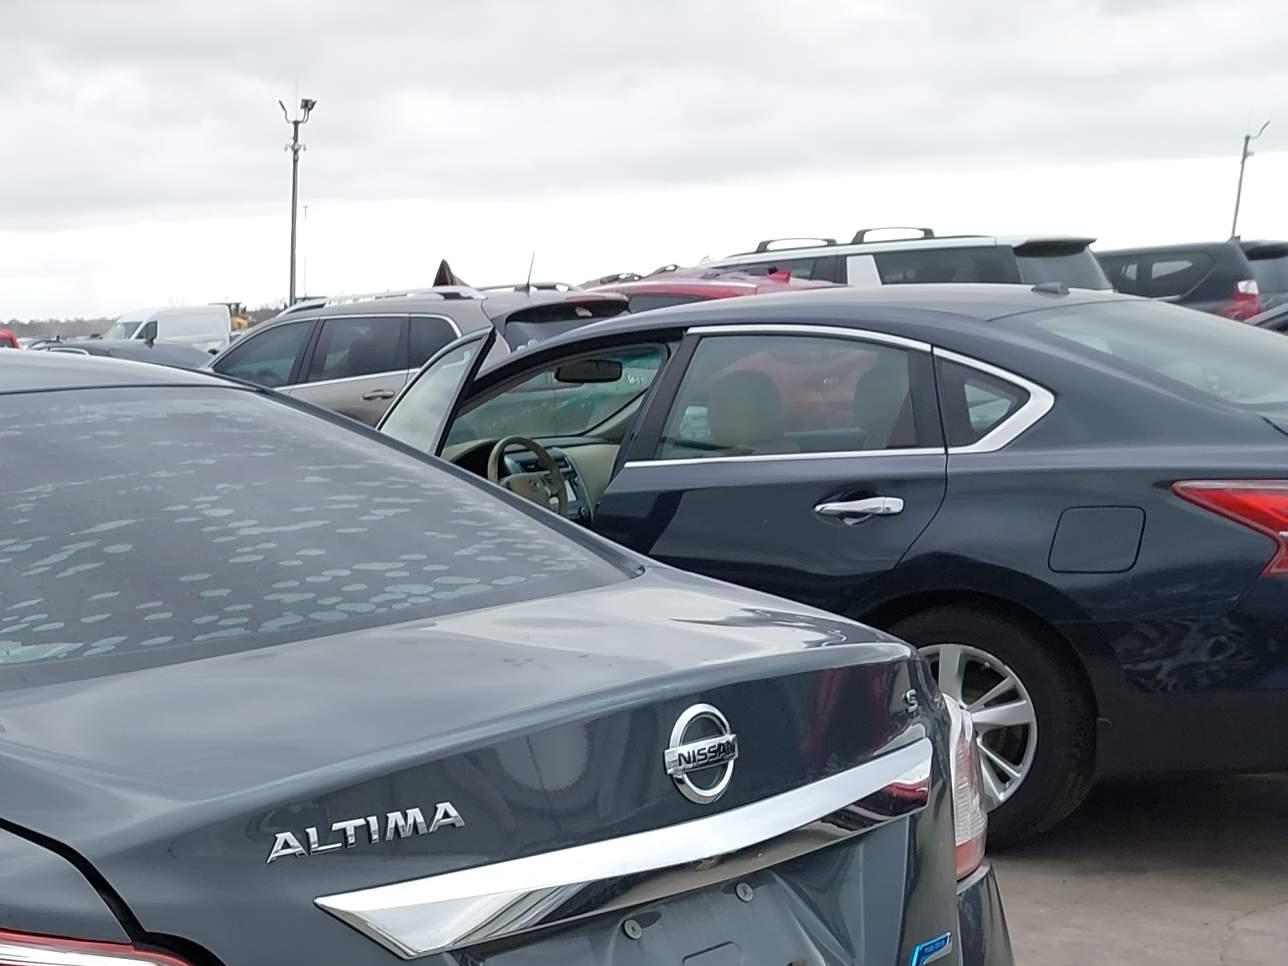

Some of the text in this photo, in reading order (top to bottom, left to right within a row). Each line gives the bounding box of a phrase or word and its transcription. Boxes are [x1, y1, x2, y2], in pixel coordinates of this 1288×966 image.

[906, 688, 918, 713] S
[677, 739, 736, 768] NISSAN
[266, 801, 465, 864] ALTIMA
